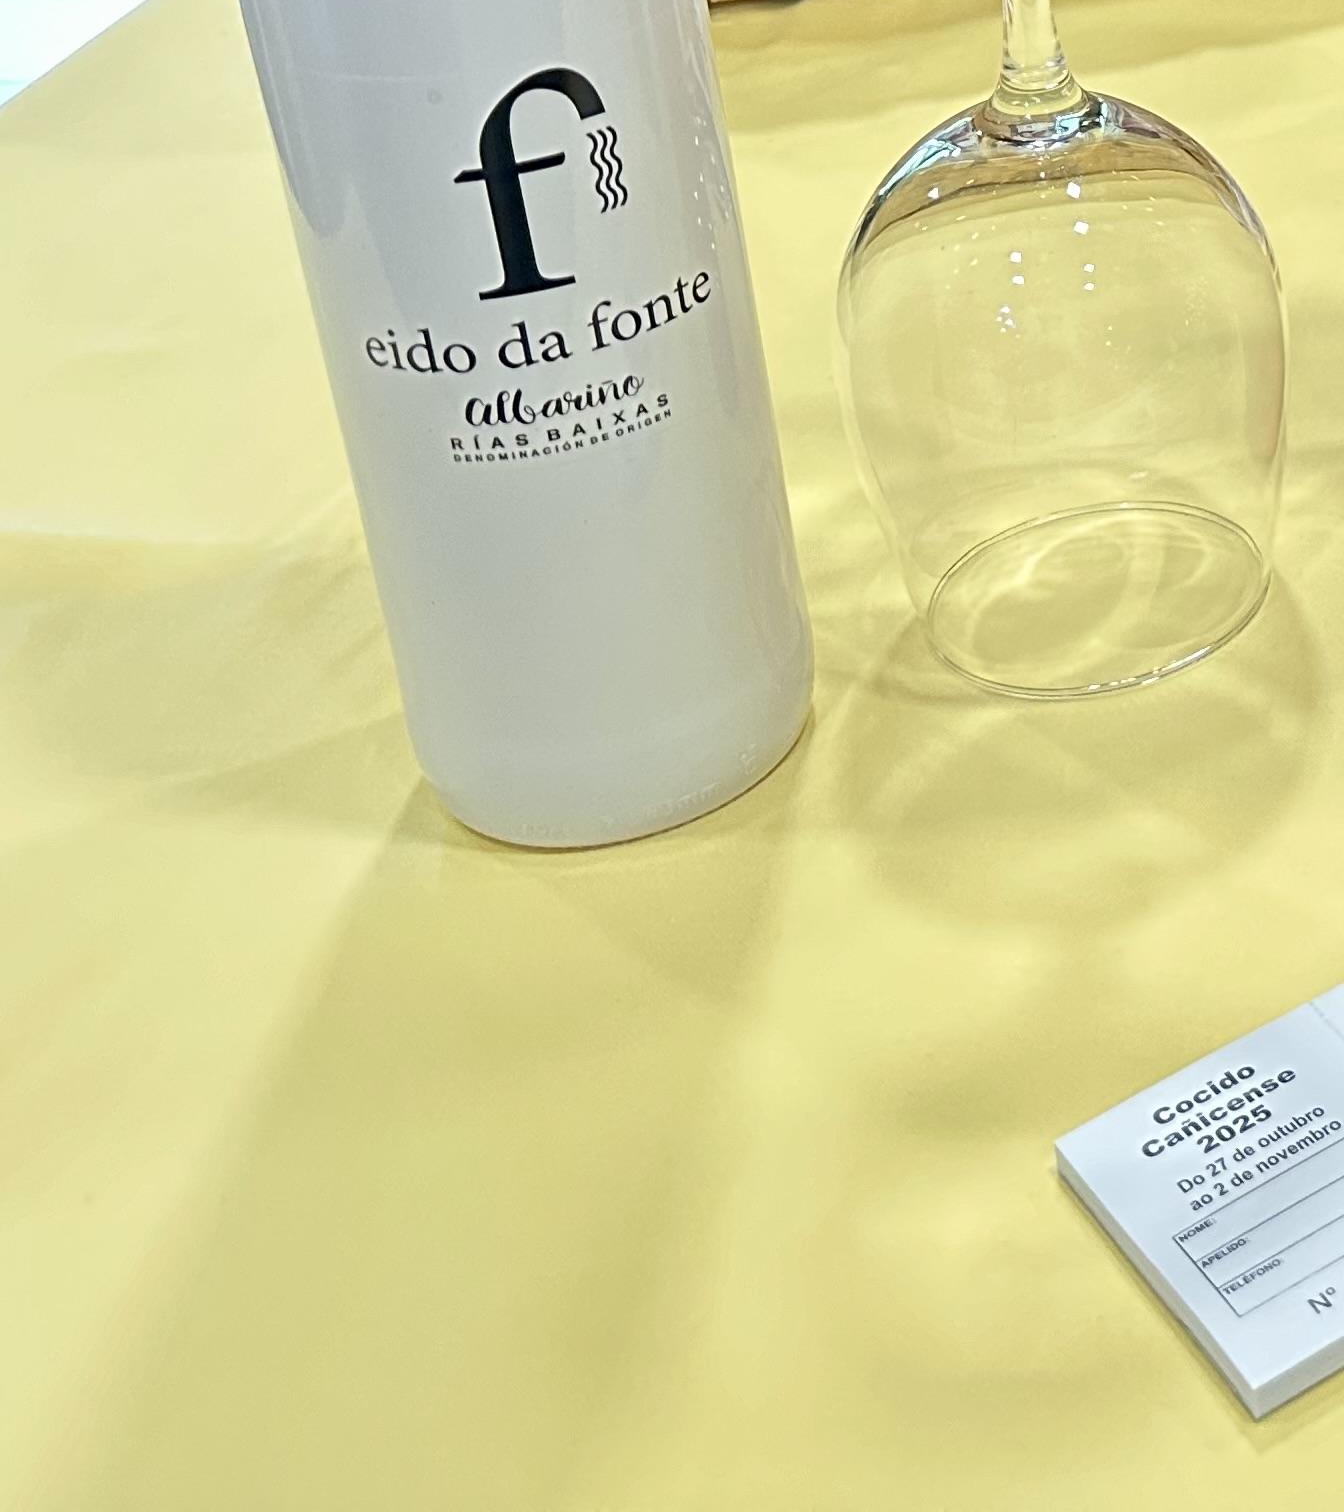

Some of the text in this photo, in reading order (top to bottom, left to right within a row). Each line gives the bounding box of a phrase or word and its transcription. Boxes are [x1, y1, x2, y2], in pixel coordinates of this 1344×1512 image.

[366, 271, 712, 374] eido da fonte
[451, 393, 670, 451] RÍAS BAIXAS
[453, 439, 584, 463] DENOMINACIÓN
[590, 432, 610, 445] DE
[1141, 1066, 1297, 1159] Cañicense
[1152, 1063, 1256, 1126] Cocido
[1177, 1104, 1326, 1194] Do 27 de outubro
[1196, 1104, 1273, 1154] 2025
[1190, 1118, 1343, 1212] ao 2 de novembro
[1177, 1217, 1216, 1243] NOME:
[1307, 1286, 1338, 1316] Nº
